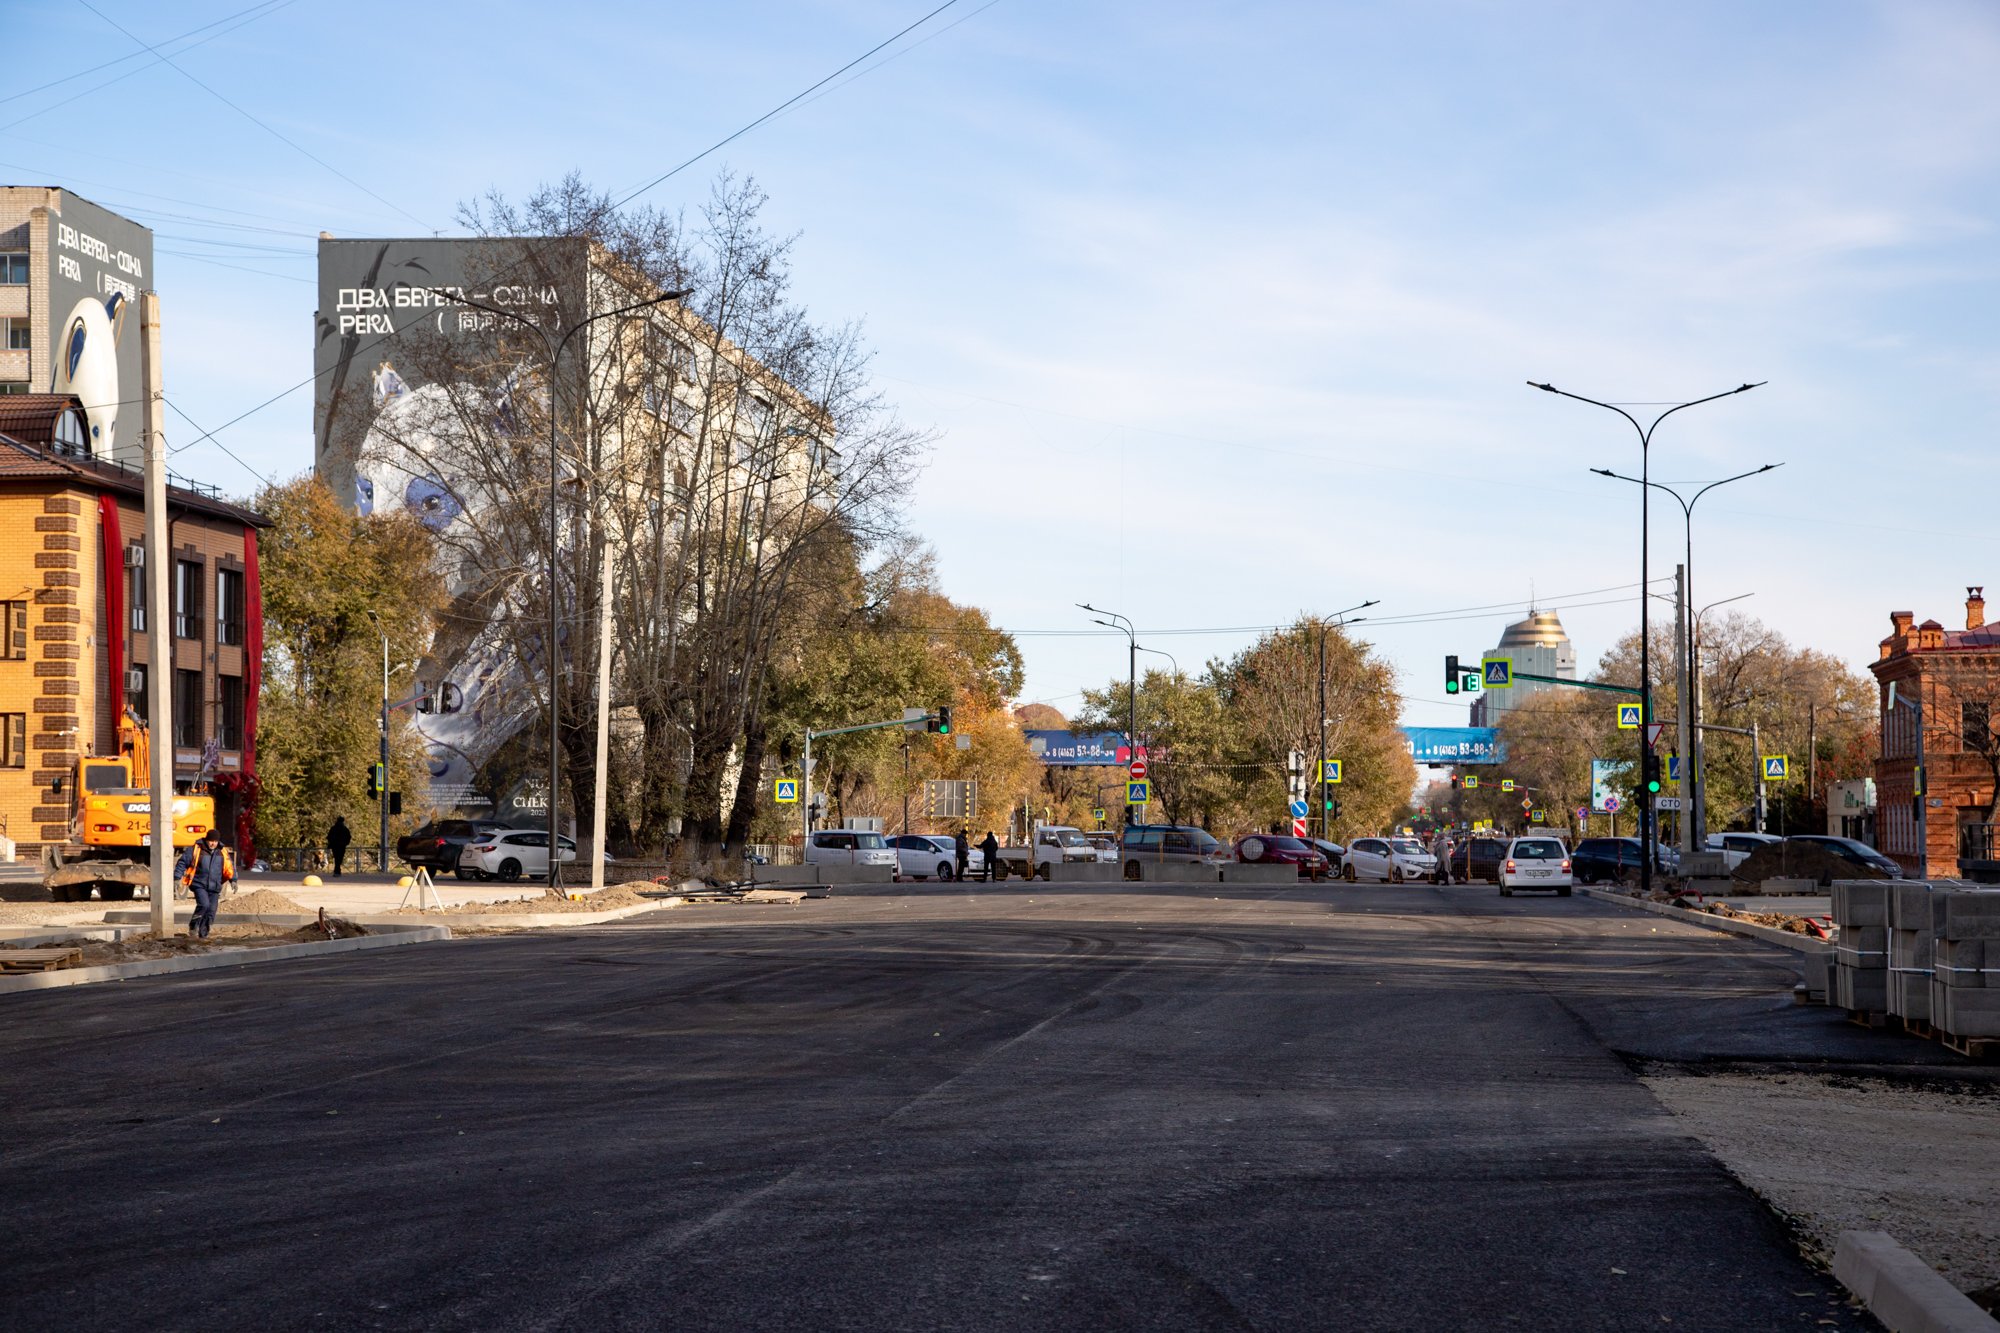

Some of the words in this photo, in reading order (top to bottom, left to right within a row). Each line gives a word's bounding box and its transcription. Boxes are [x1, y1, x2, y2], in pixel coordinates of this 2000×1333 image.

[58, 222, 80, 251] ДВА
[81, 232, 110, 264] БЕРЕГА
[117, 250, 142, 278] ОДНА
[59, 254, 82, 283] РЕКА
[337, 288, 389, 311] ДВА
[394, 286, 468, 308] БЕРЕГА
[339, 314, 395, 335] РЕКА
[1660, 799, 1681, 808] СТО
